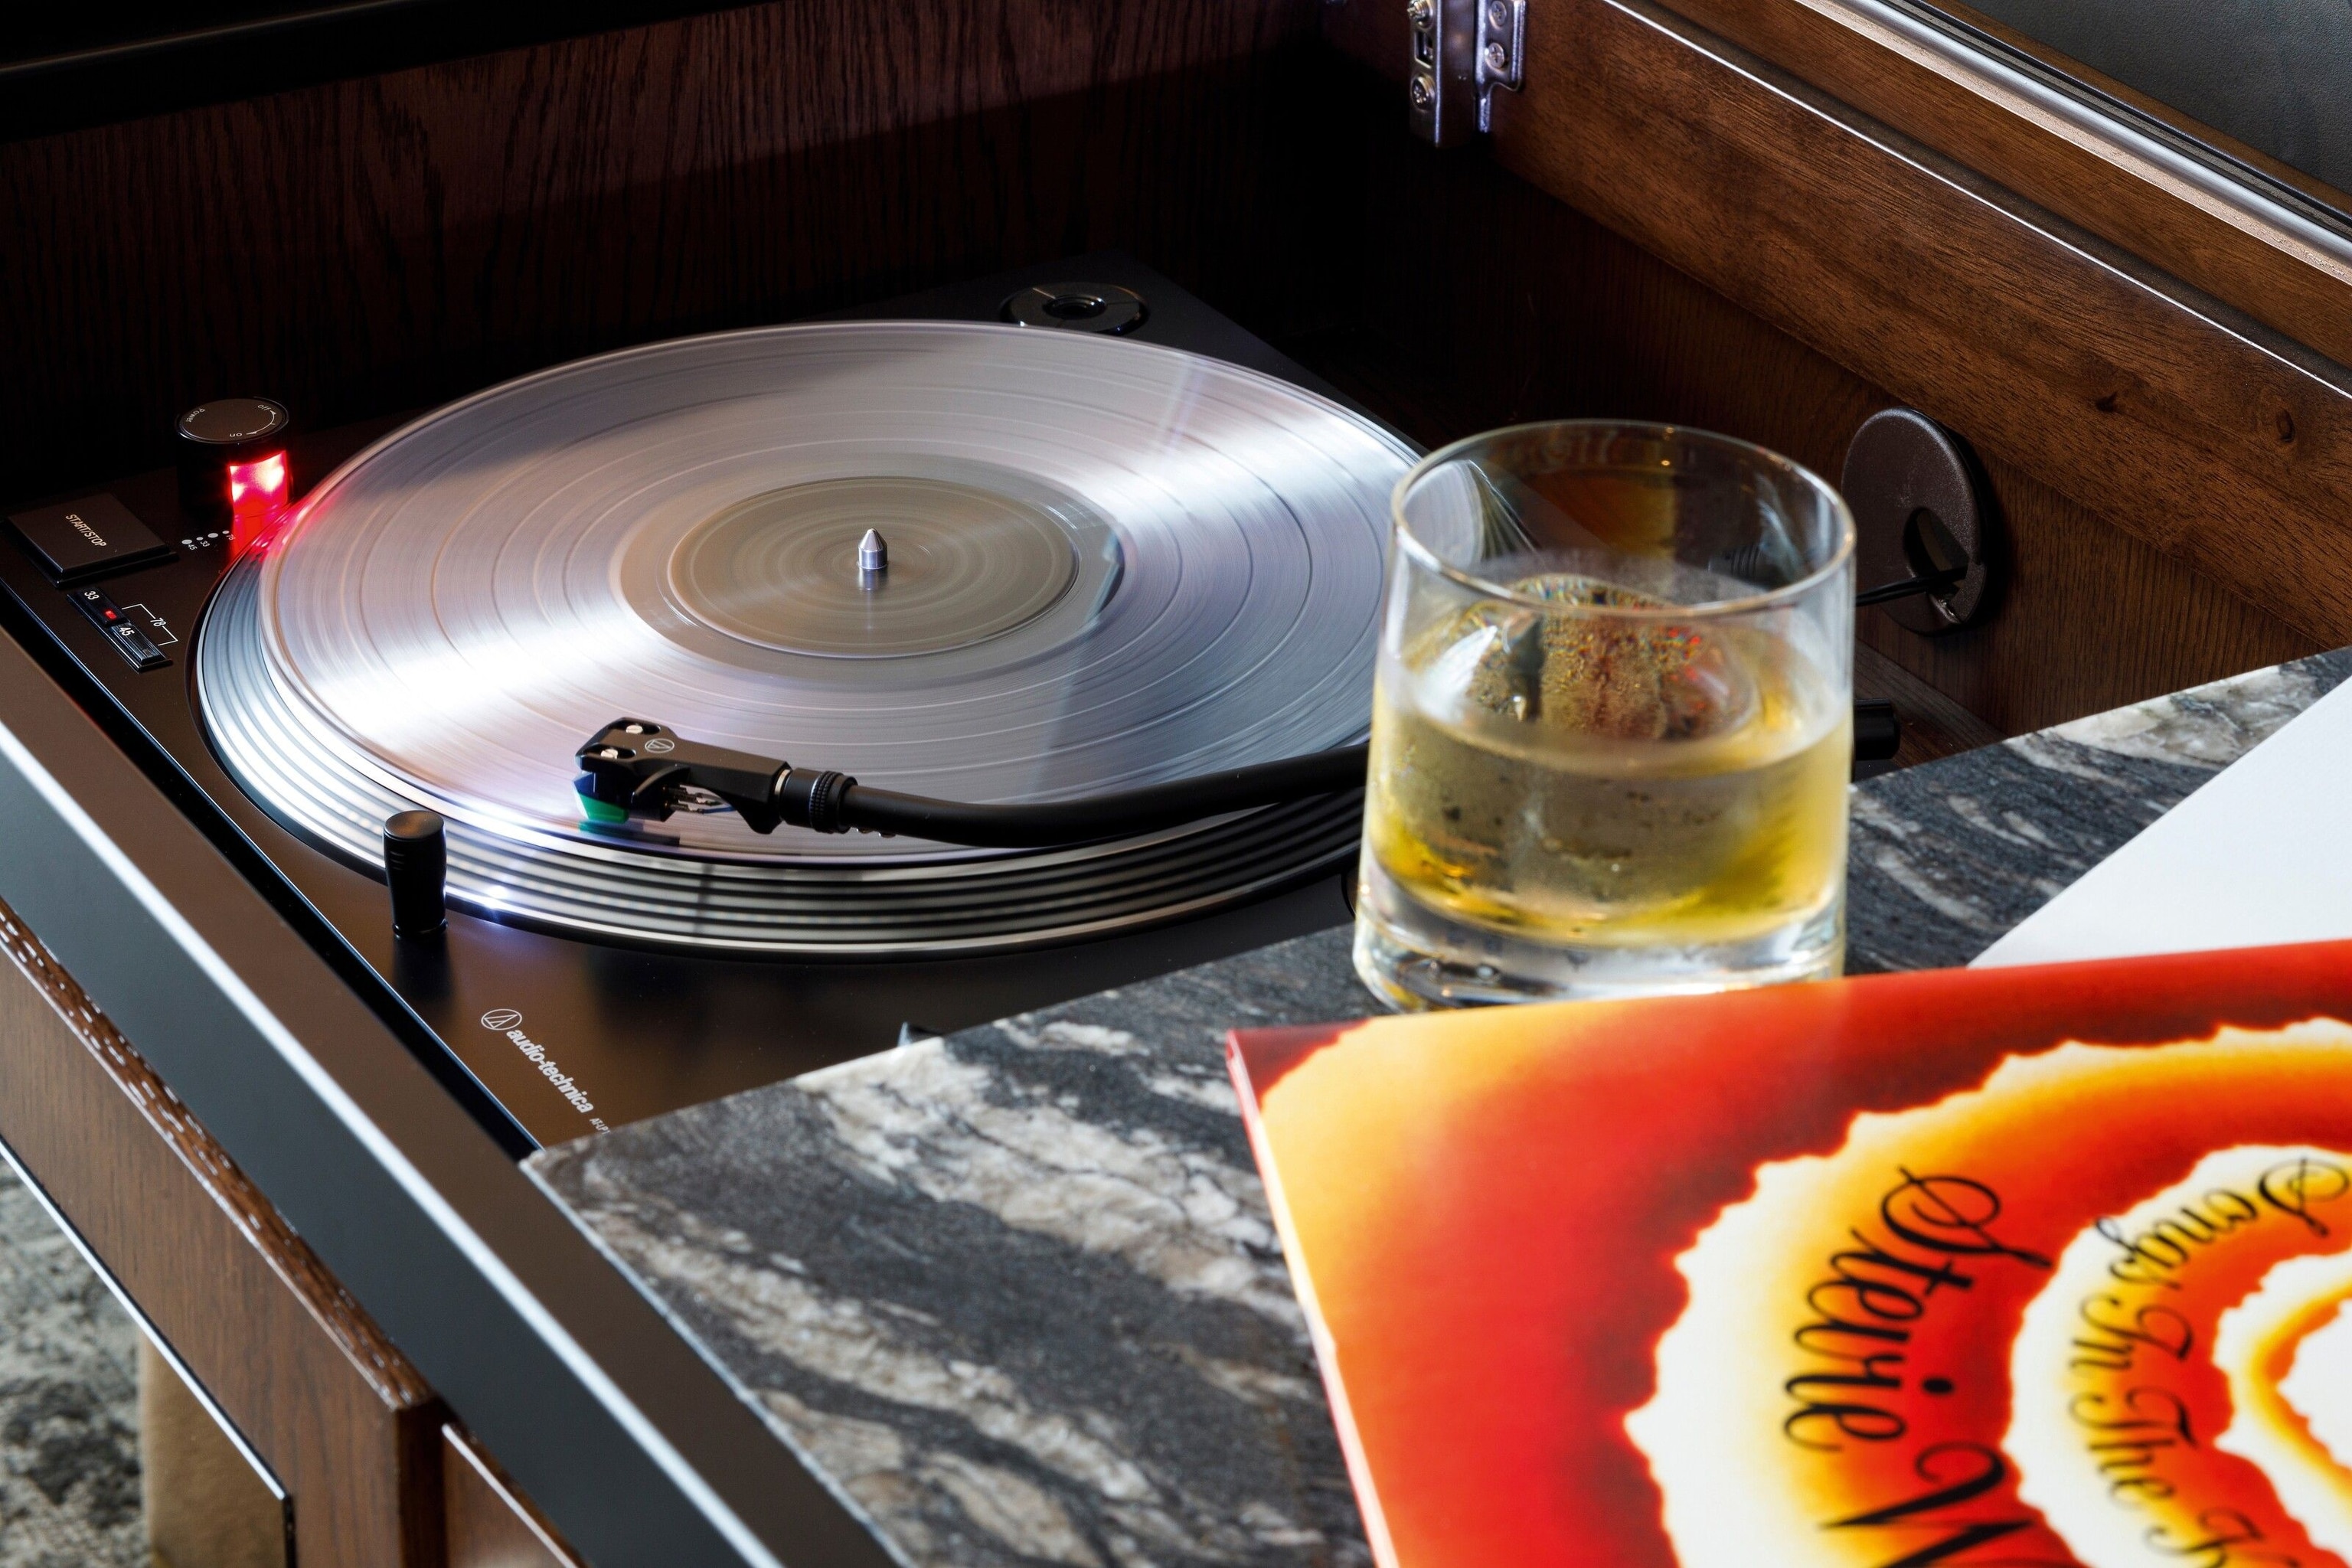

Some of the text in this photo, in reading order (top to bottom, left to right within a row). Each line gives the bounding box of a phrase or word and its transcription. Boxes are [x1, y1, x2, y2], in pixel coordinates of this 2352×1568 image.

[66, 514, 107, 547] START/STOP
[84, 591, 100, 600] 33
[119, 627, 136, 636] 45
[150, 617, 167, 627] 78
[506, 1030, 594, 1113] audio-technica
[1783, 1166, 2054, 1453] Stevie
[2068, 1158, 2349, 1511] Songs In The
